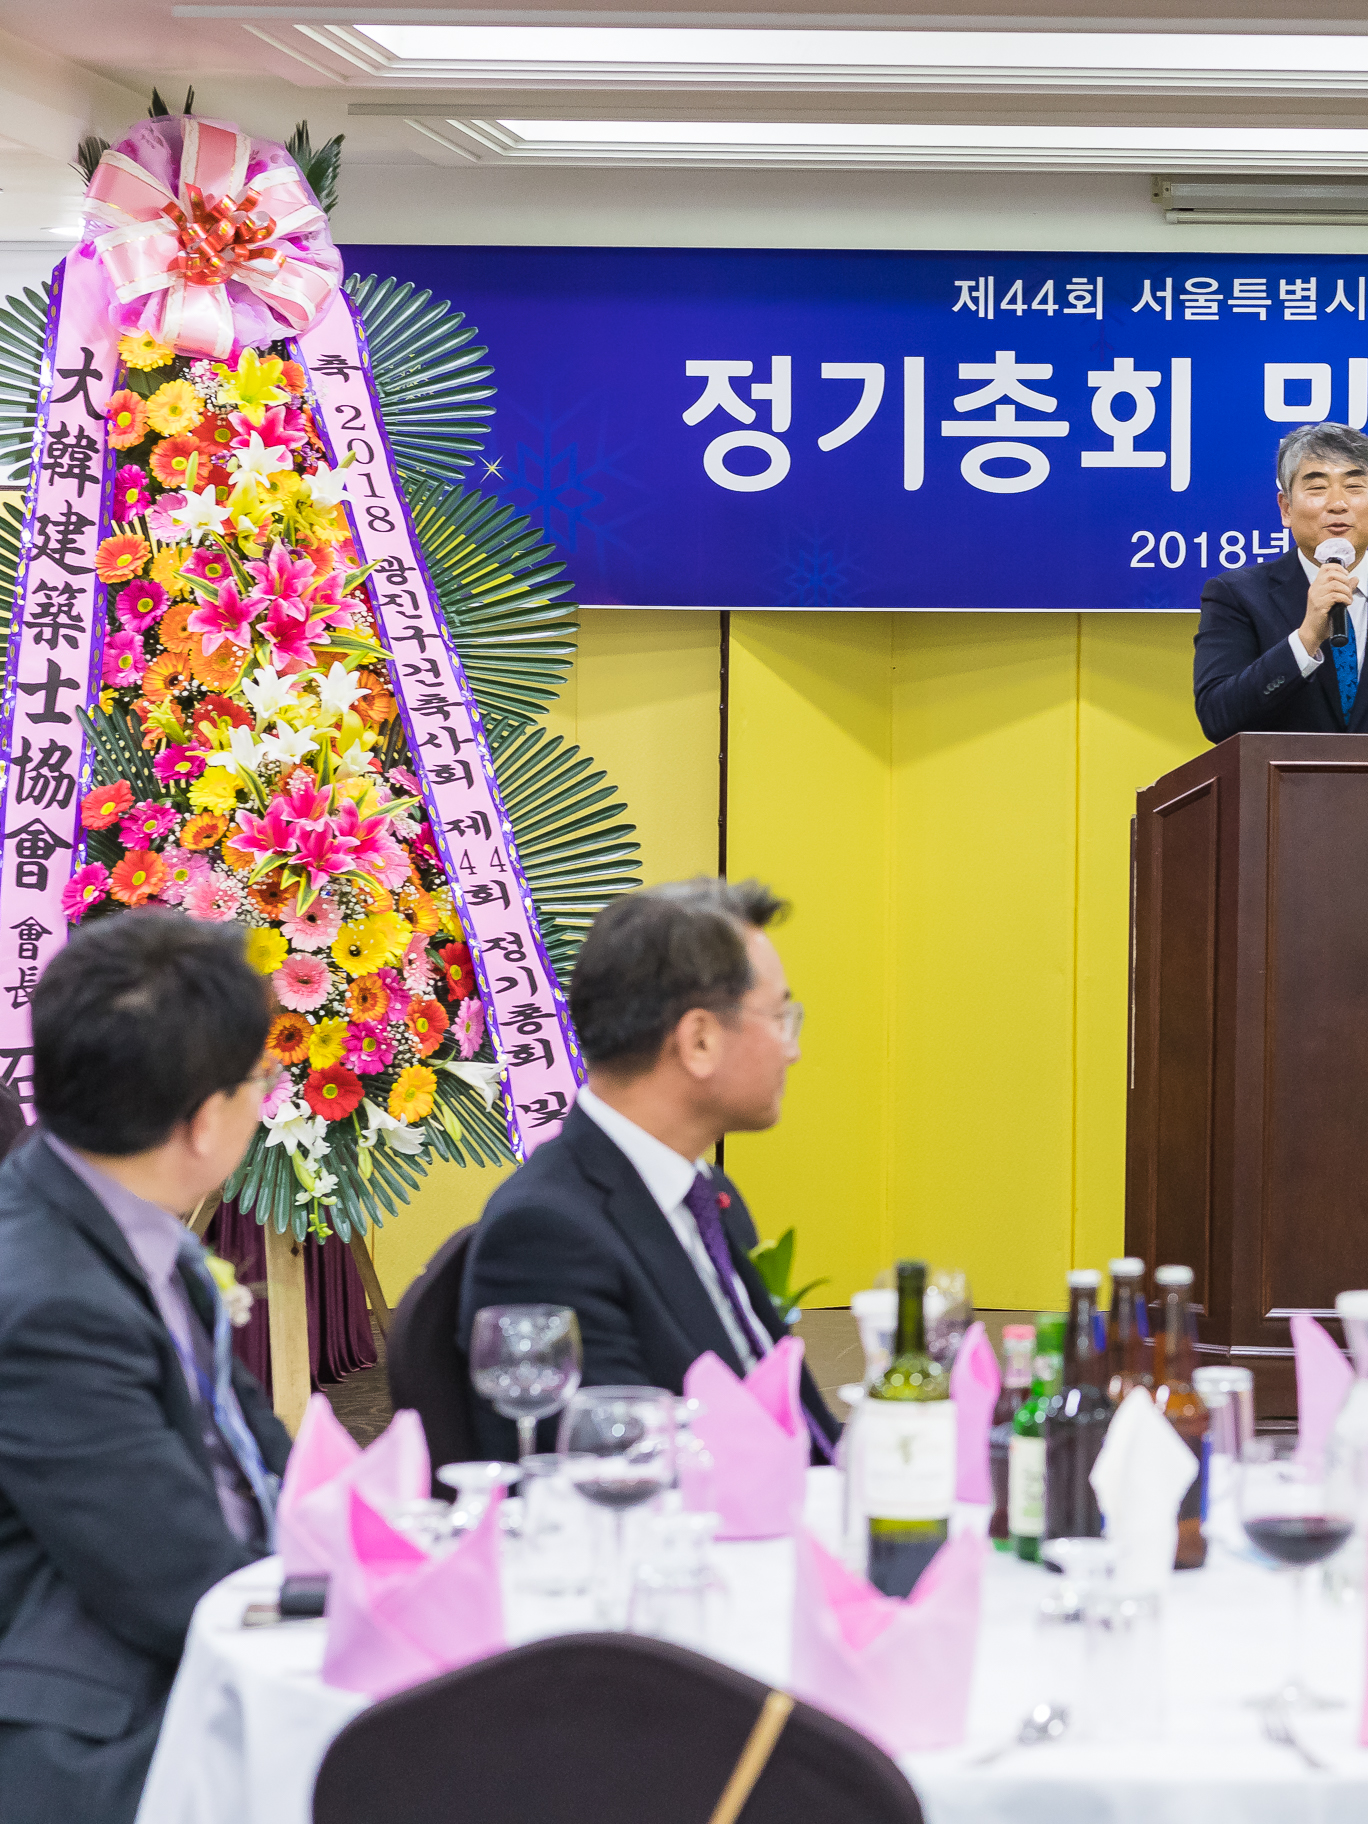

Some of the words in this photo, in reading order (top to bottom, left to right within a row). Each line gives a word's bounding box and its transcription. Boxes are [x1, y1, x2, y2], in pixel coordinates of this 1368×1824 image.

[951, 275, 1104, 321] 제44회
[1131, 276, 1367, 321] 서울특별시
[309, 354, 362, 384] 축
[682, 351, 1192, 494] 정기총회
[333, 403, 396, 534] 2018
[1130, 529, 1290, 570] 2018년
[4, 346, 106, 893] 大韓建築士協會
[372, 556, 475, 790] 광진구건축사회
[481, 931, 557, 1071] 정기총회
